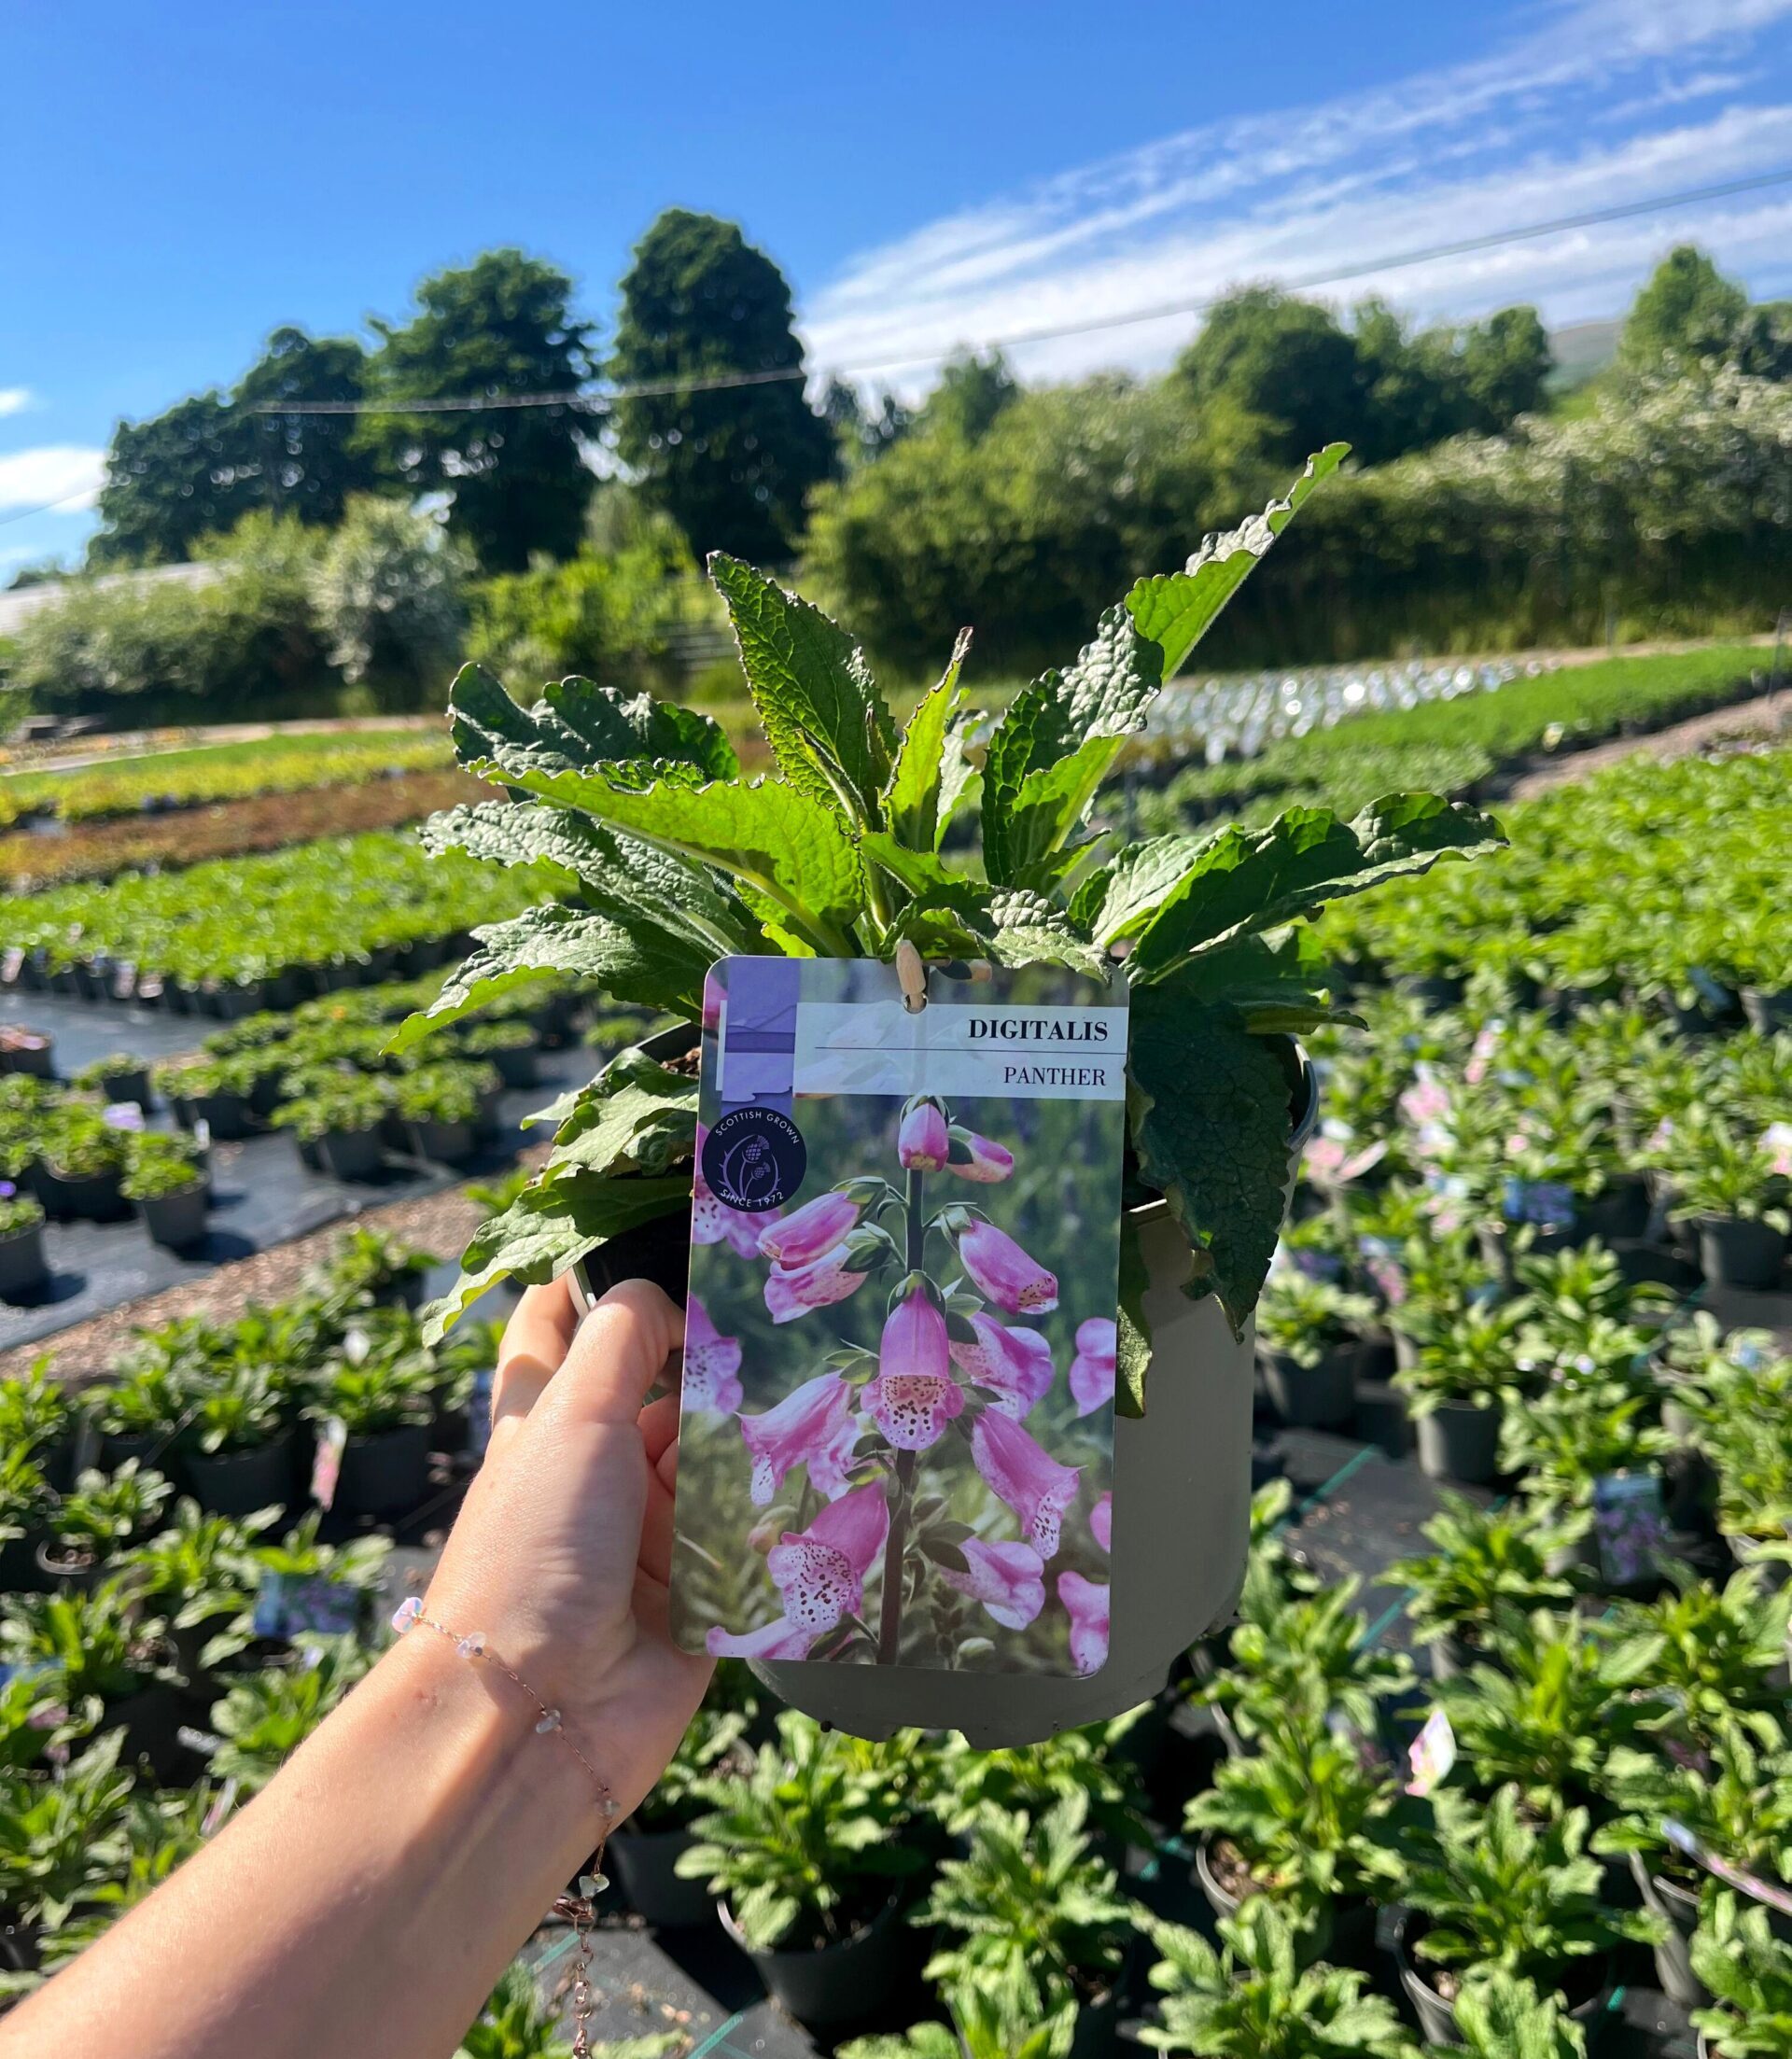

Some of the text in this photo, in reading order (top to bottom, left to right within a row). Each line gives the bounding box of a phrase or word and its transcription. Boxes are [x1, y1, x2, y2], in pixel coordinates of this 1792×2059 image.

[968, 1019, 1108, 1041] DIGITALIS
[1003, 1067, 1106, 1086] PANTHER
[715, 1111, 800, 1144] SCOTTISH GROWN
[720, 1189, 784, 1207] SINCE 1972
